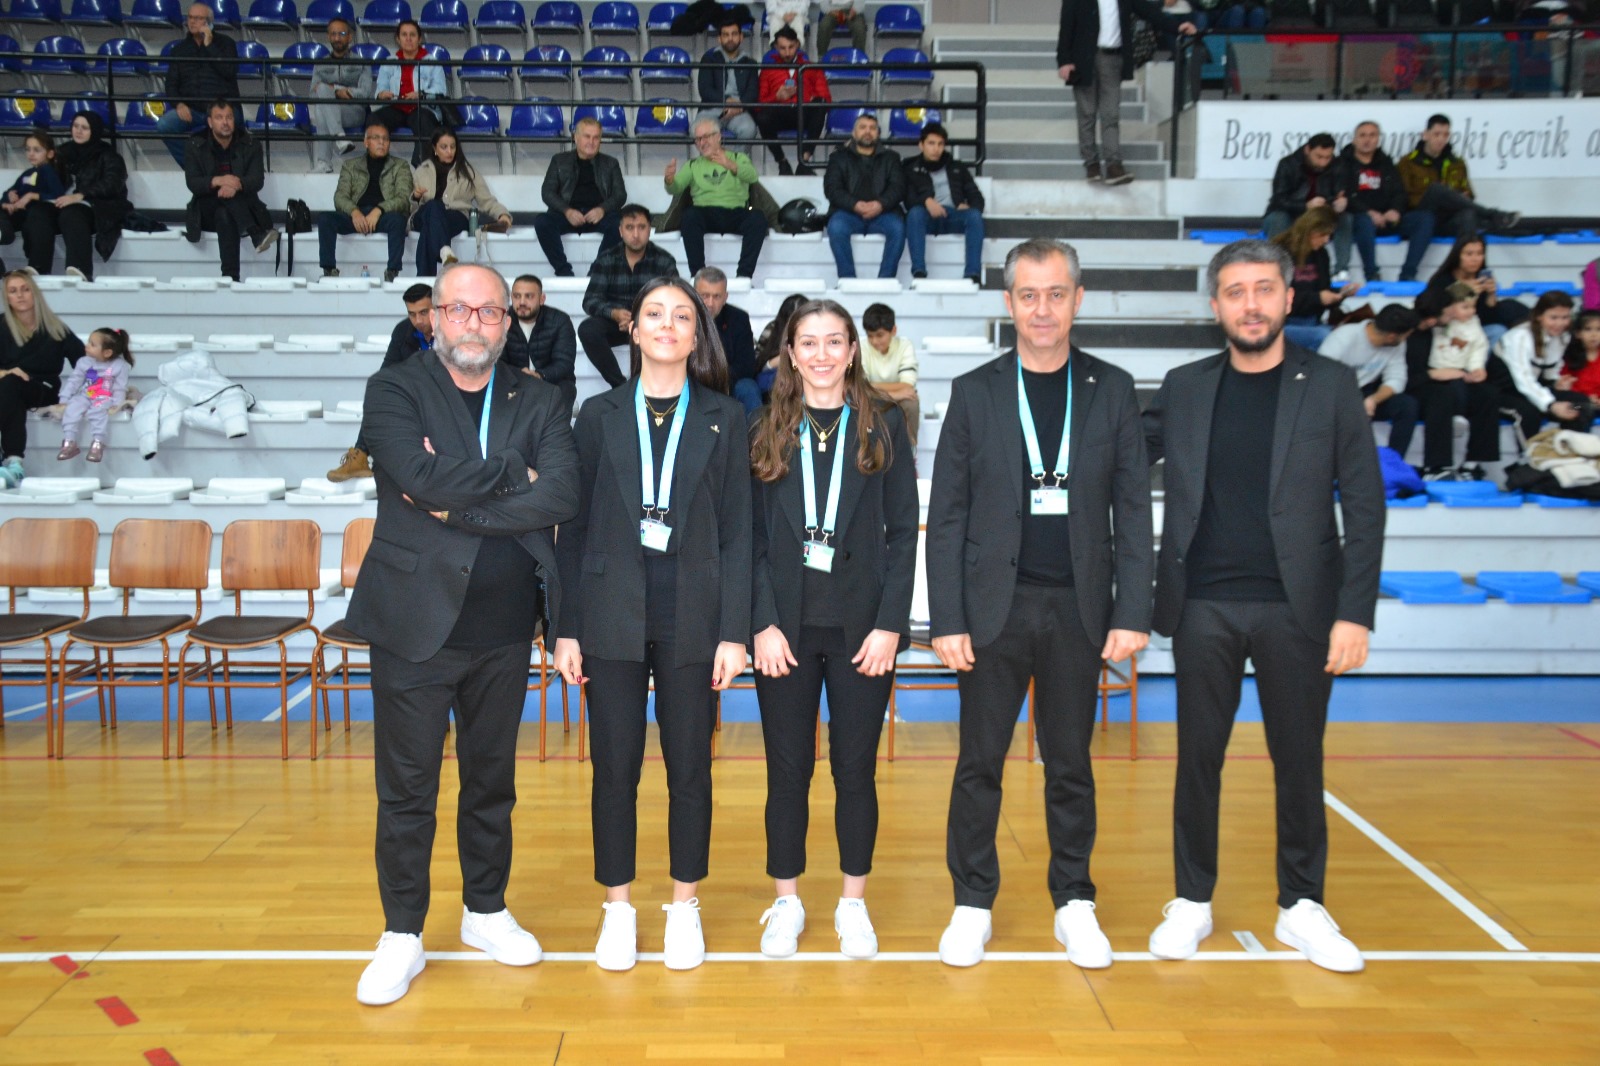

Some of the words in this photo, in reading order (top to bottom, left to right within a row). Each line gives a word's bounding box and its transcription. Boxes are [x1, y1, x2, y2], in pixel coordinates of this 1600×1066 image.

[1221, 118, 1273, 160] Ben
[1448, 116, 1490, 160] eki
[1496, 115, 1571, 170] çevik
